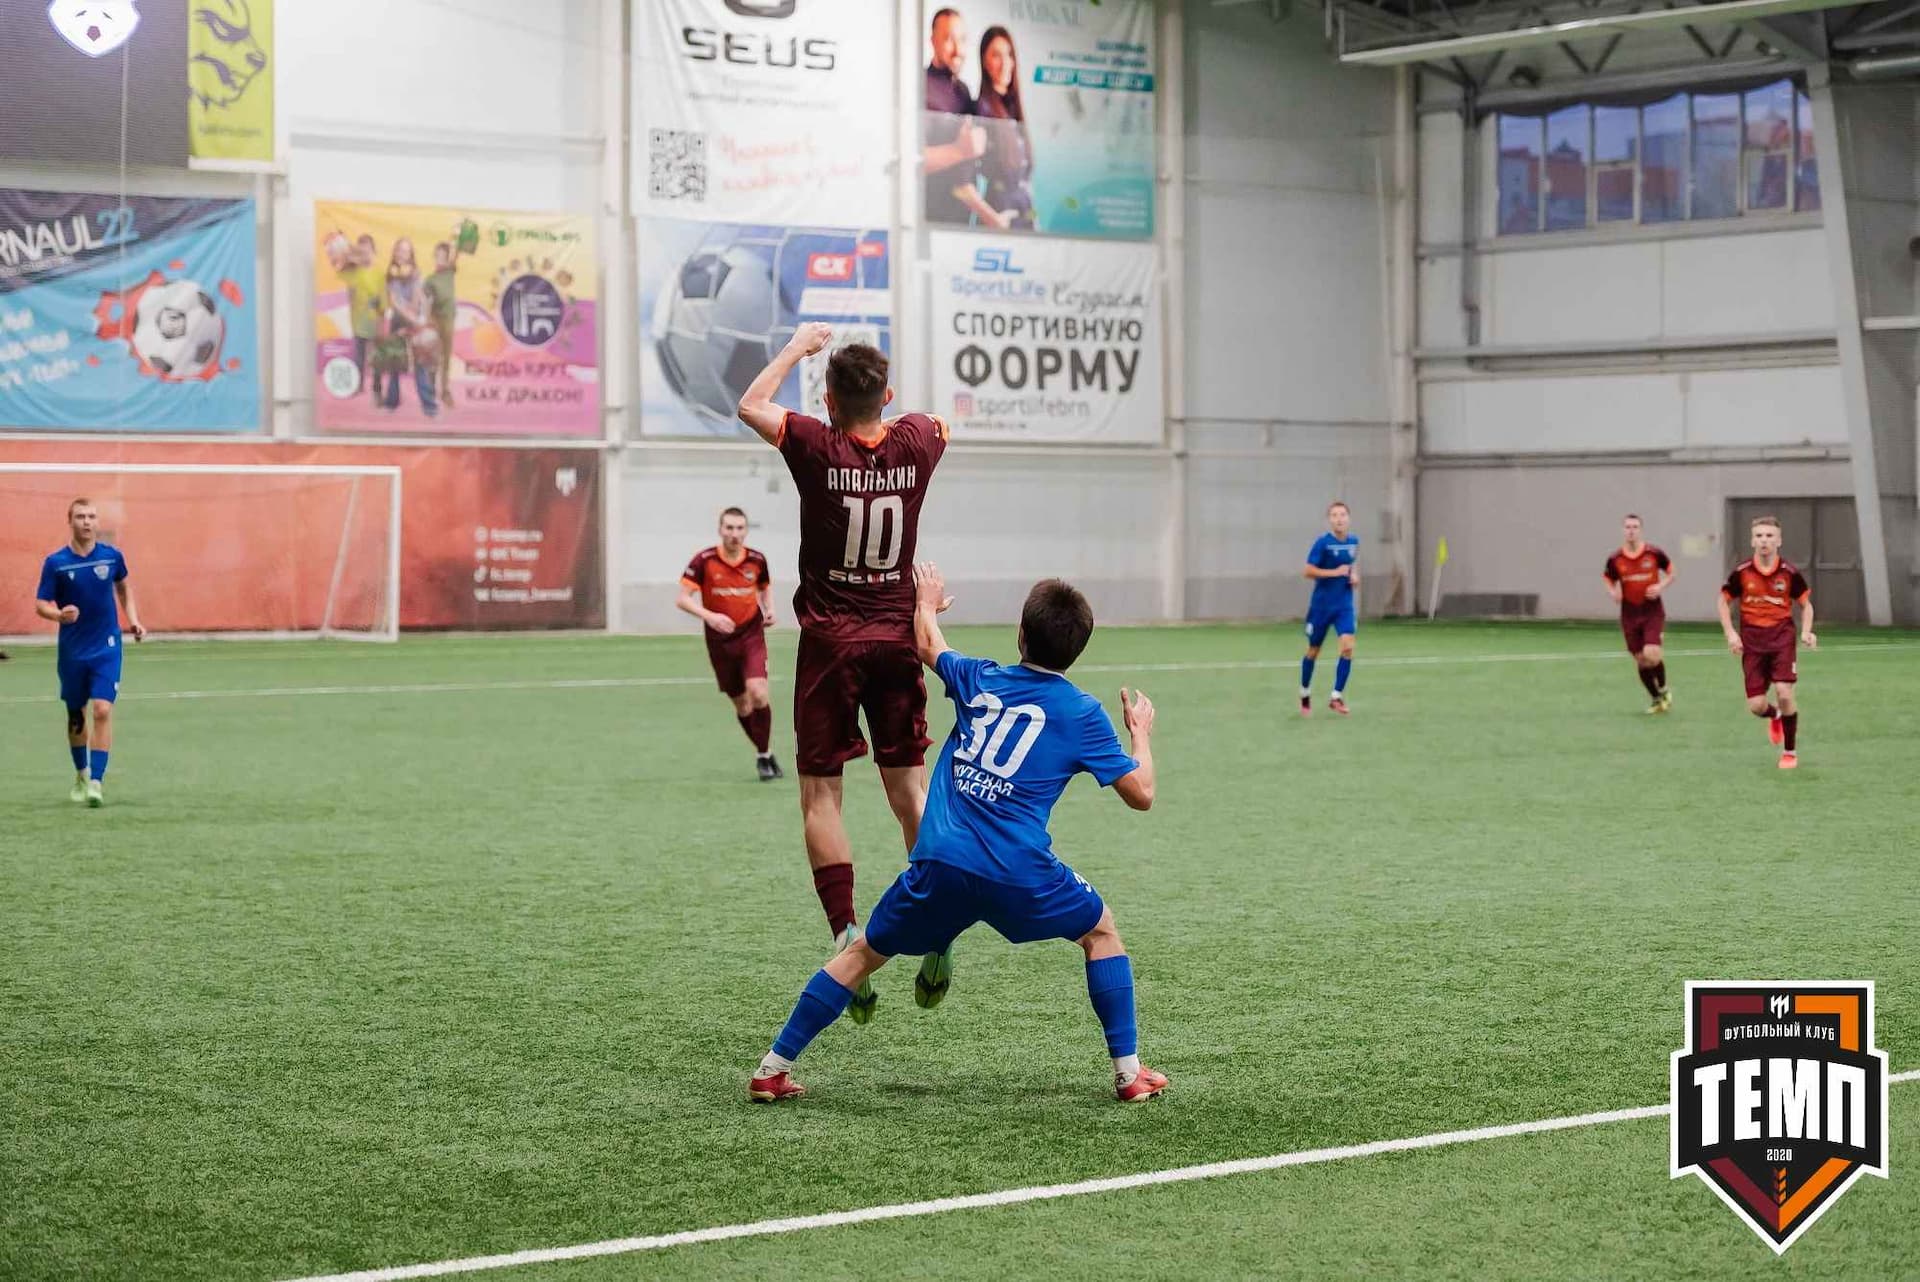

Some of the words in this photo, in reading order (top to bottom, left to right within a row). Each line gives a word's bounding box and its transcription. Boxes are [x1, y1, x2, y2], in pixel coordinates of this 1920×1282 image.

[682, 27, 836, 70] SEUS
[972, 247, 1024, 273] SL
[951, 276, 1047, 299] SportLife
[953, 312, 1143, 343] СПОРТИВНУЮ
[954, 344, 1140, 393] ФОРМУ
[827, 465, 916, 492] АПАЛЬКИН
[842, 495, 904, 570] 10
[828, 569, 901, 585] SEUS
[953, 692, 1047, 779] 30
